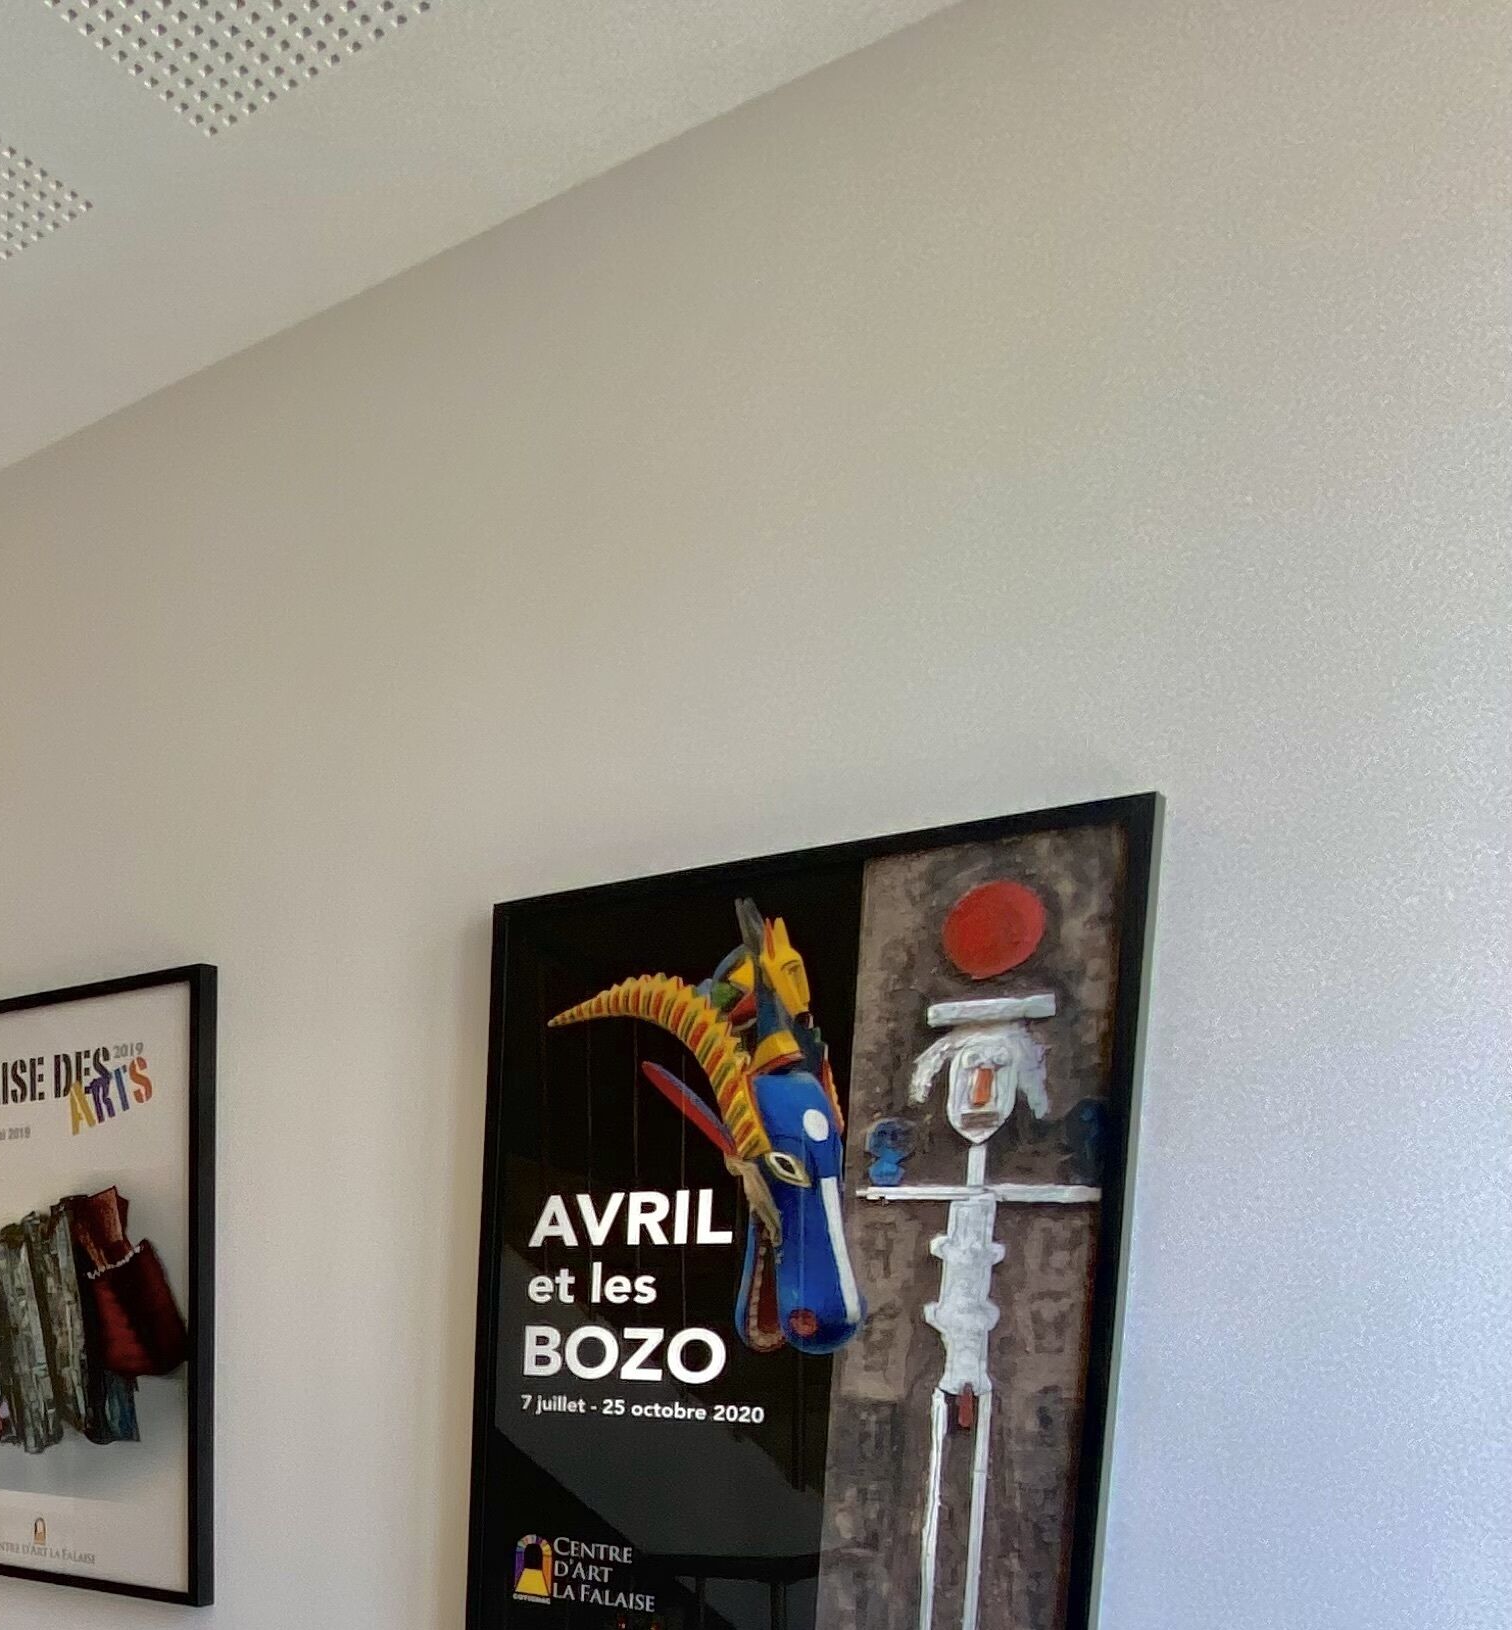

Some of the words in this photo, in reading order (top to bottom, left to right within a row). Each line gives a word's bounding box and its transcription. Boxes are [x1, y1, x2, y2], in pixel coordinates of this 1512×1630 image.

[112, 1042, 144, 1059] 2019
[68, 1056, 153, 1136] ARTS
[8, 1126, 31, 1140] 2019
[528, 1188, 733, 1247] AVRIL
[527, 1267, 576, 1304] et
[590, 1261, 657, 1305] les
[522, 1324, 727, 1385] BOZO
[520, 1394, 533, 1410] 7
[535, 1395, 586, 1415] juillet
[602, 1399, 626, 1416] 25
[630, 1401, 707, 1421] octobre
[712, 1404, 765, 1424] 2020
[553, 1537, 633, 1564] CENTRE
[554, 1559, 613, 1583] D'ART
[553, 1583, 575, 1600] LA
[580, 1584, 656, 1613] FALAISE
